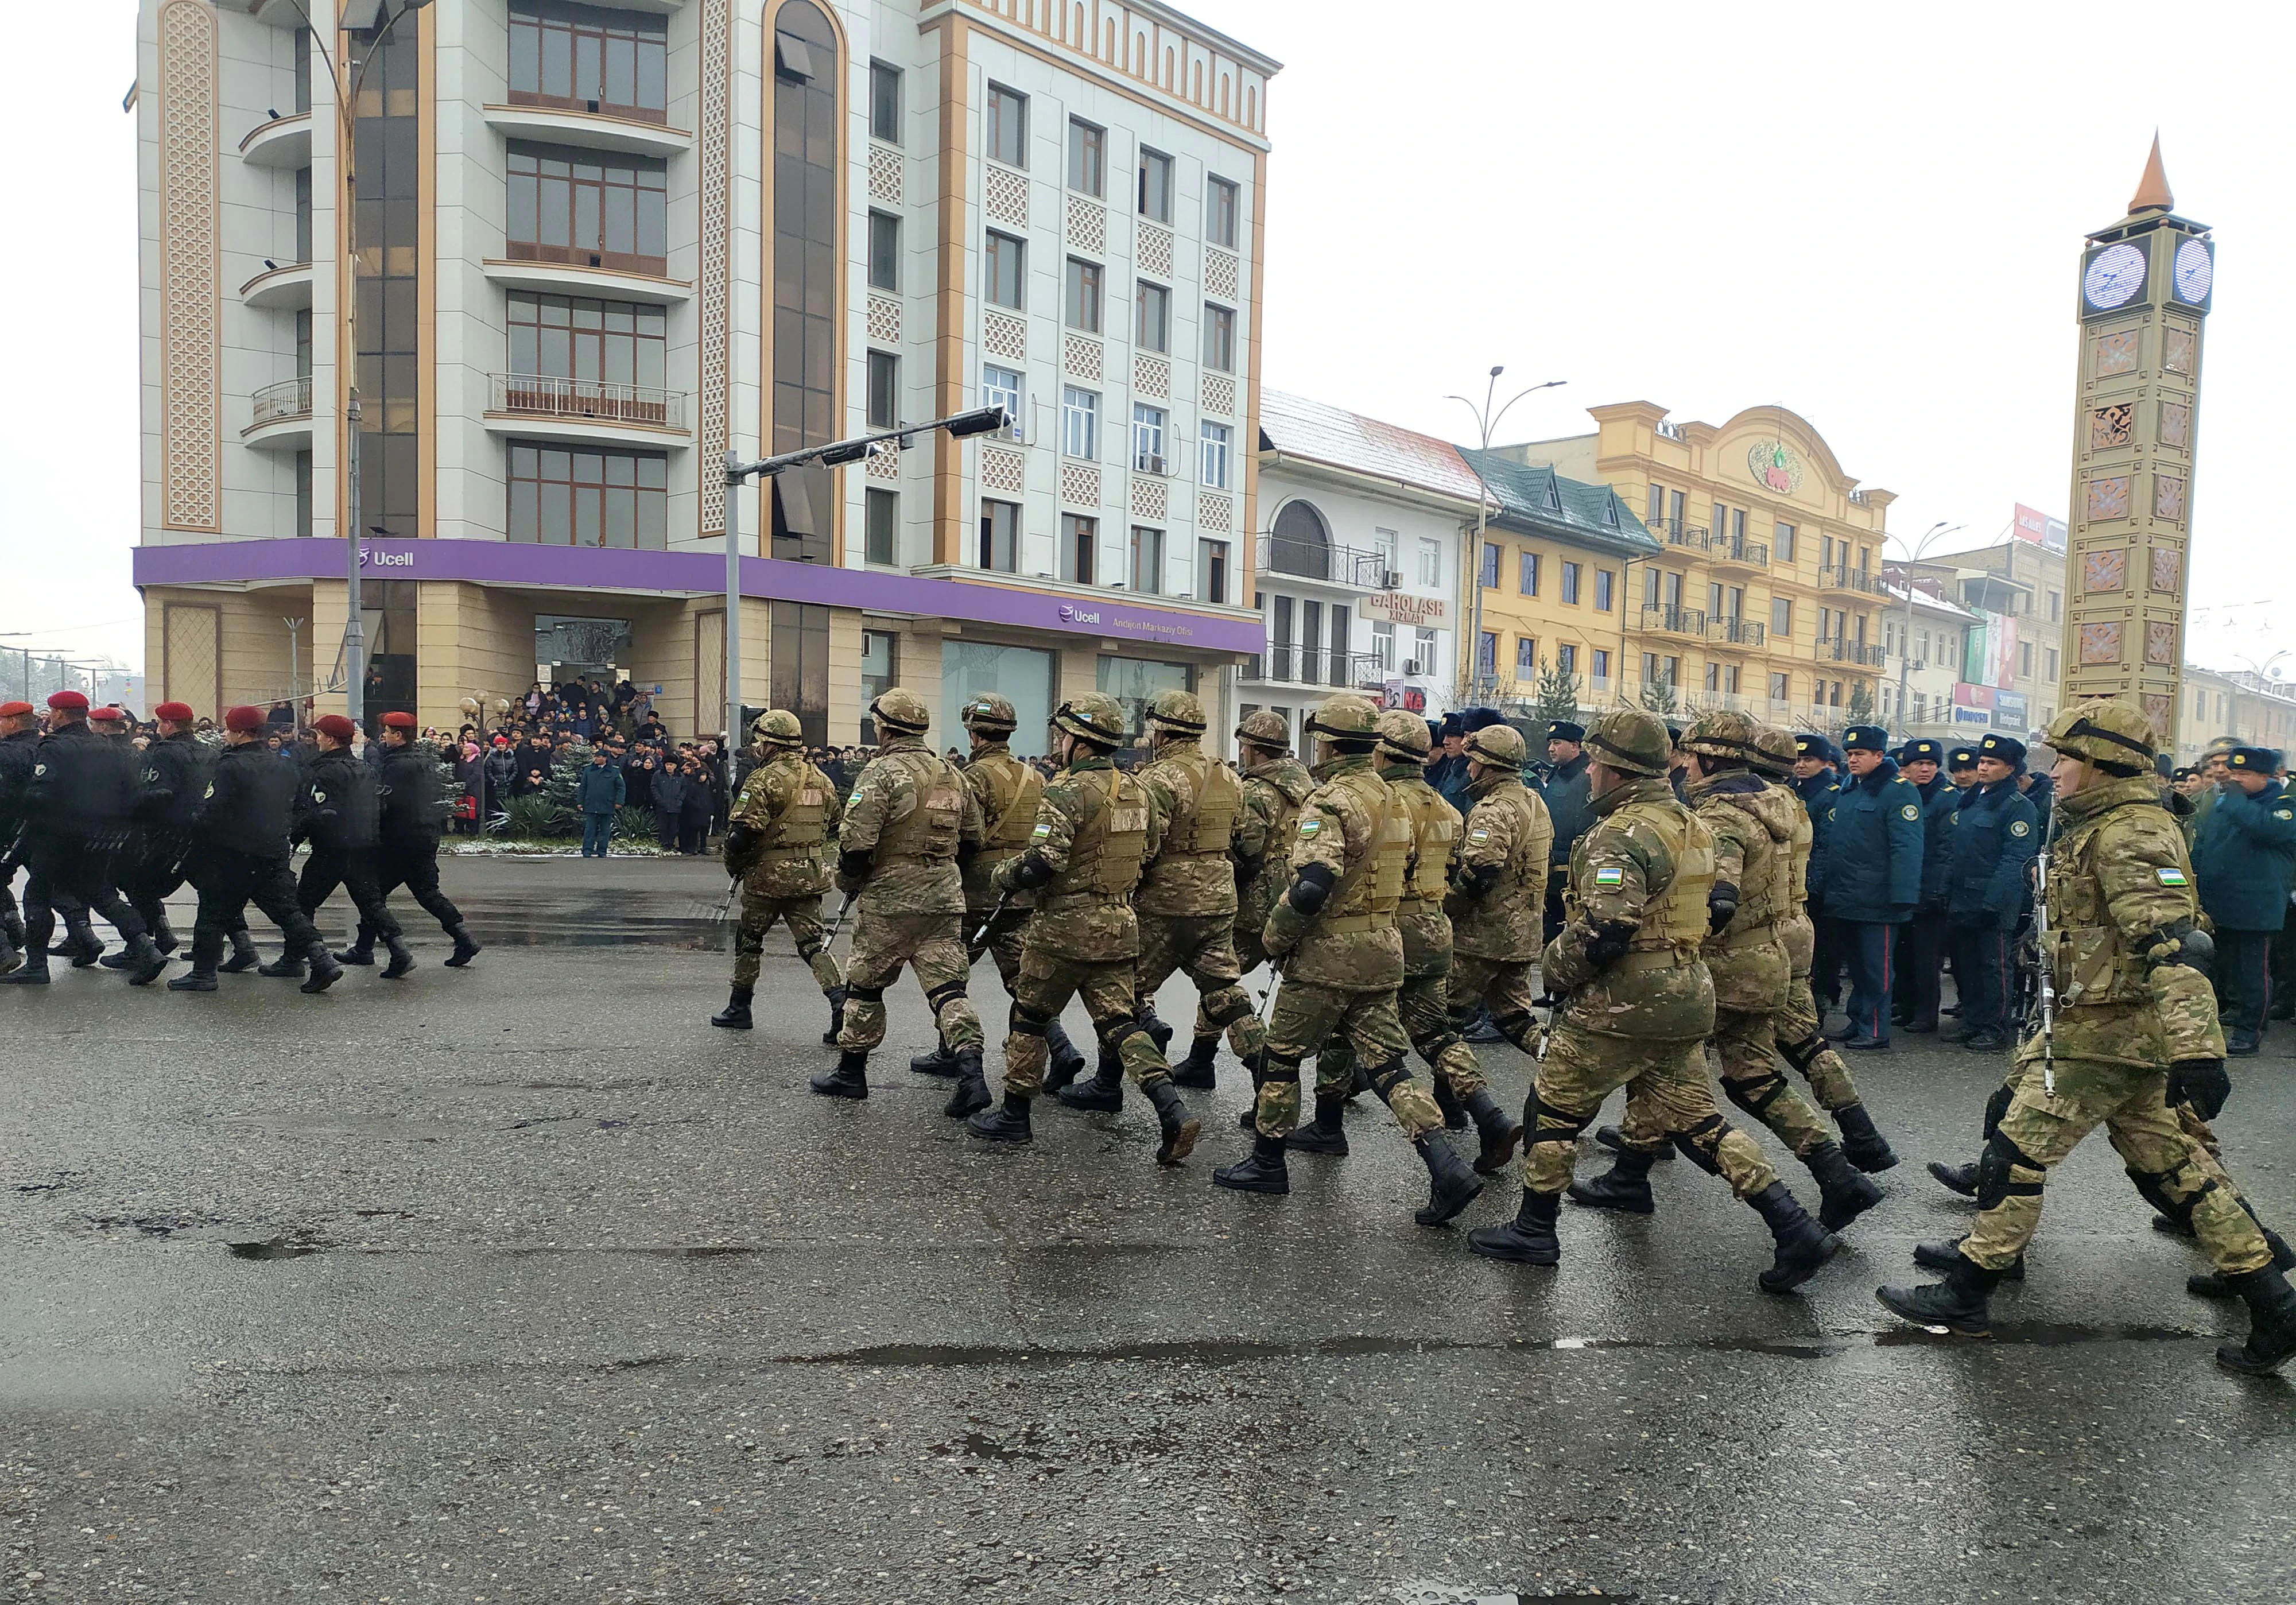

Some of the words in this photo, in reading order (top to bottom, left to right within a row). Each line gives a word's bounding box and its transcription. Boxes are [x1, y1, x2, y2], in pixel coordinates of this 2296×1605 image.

[374, 551, 413, 566] Ucell
[1075, 609, 1100, 625] Ucell
[1112, 618, 1141, 630] Andijon
[1143, 622, 1176, 635] Markaziy
[1177, 626, 1193, 636] Ofisi
